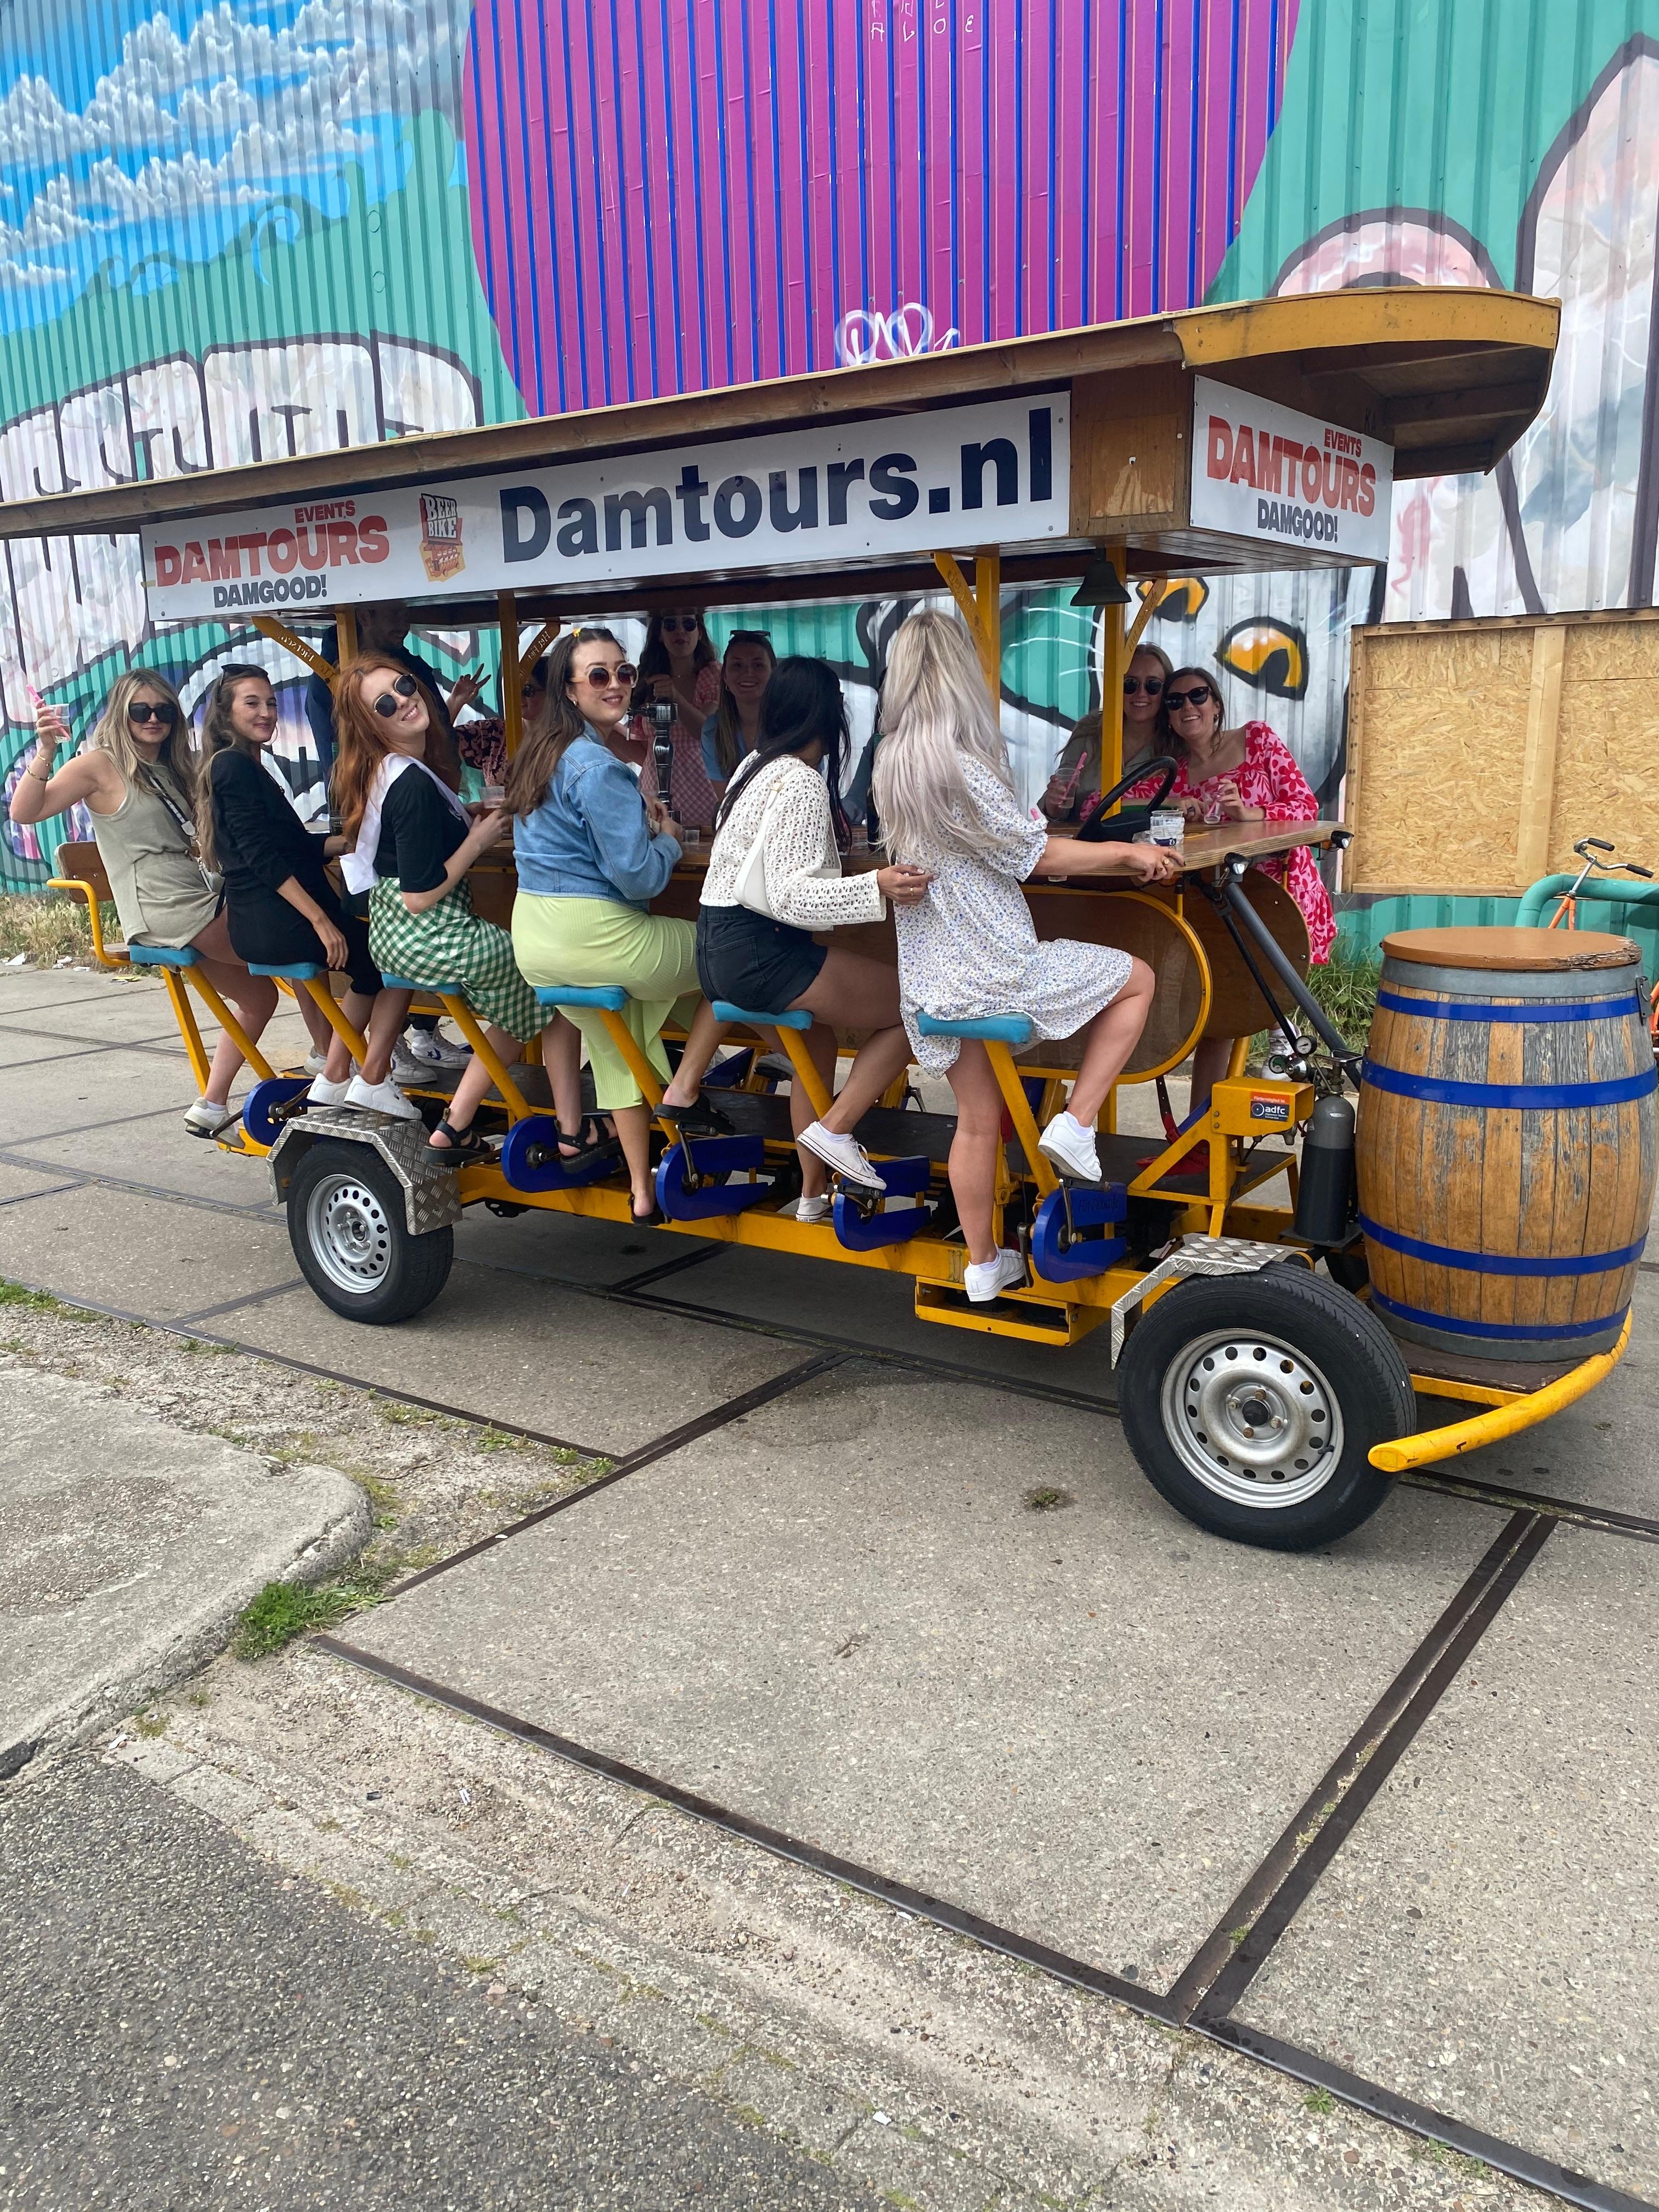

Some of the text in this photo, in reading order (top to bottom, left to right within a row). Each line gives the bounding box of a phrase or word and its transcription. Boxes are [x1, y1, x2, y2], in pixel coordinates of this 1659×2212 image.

[1324, 428, 1362, 458] EVENTS
[1207, 415, 1376, 517] DAMTOURS
[499, 407, 1053, 563] Damtours.nl
[295, 500, 356, 524] EVENTS
[424, 495, 456, 521] BEER
[1258, 498, 1338, 543] DAMGOOD!
[427, 516, 456, 538] BIKE
[154, 515, 391, 587] DAMTOURS
[213, 574, 328, 608] DAMGOOD!
[1265, 1106, 1286, 1114] adfc
